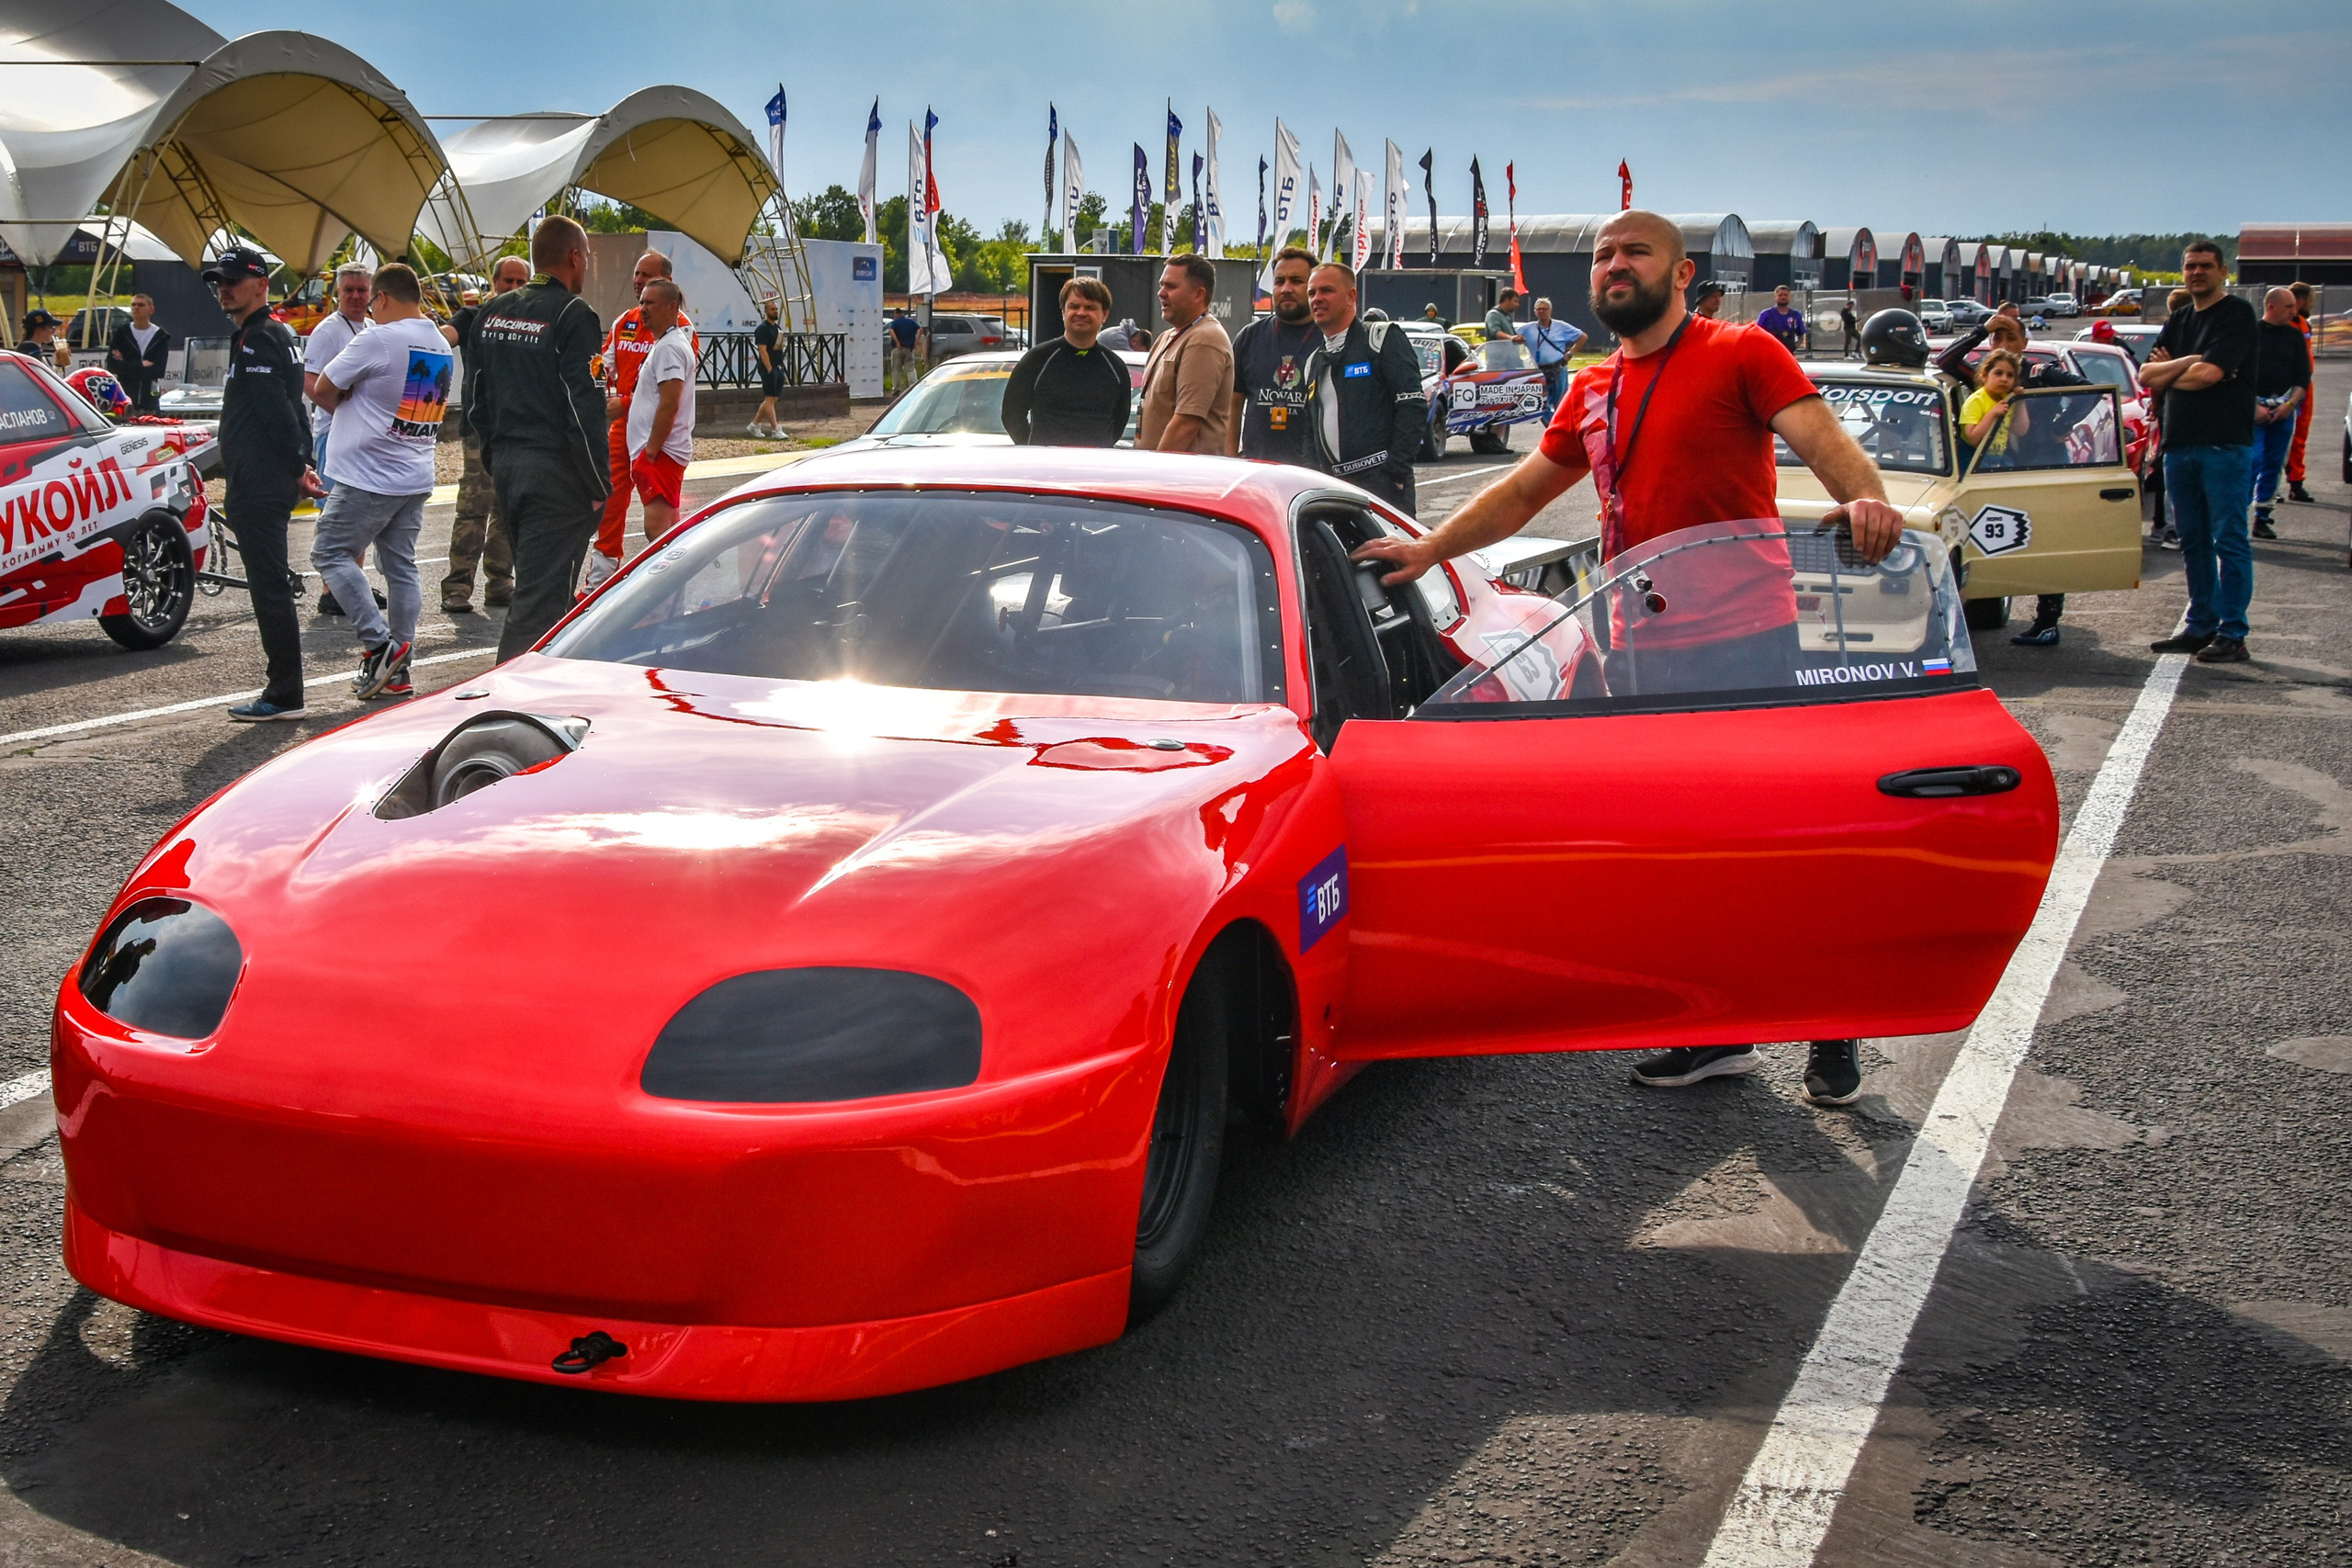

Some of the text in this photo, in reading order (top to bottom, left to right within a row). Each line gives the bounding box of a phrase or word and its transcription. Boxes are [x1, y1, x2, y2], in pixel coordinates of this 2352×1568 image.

[1278, 176, 1295, 221] ВТБ
[1166, 215, 1175, 254] NEZI
[78, 241, 97, 253] ВТБ
[1354, 366, 1368, 375] ВТБ
[1454, 389, 1475, 402] FQ
[1480, 385, 1542, 394] MADE IN JAPAN
[0, 409, 47, 431] АСЛАНОВ
[120, 437, 149, 455] GENESIS
[1343, 453, 1387, 472] DUBOVETS
[0, 457, 133, 556] УКОЙЛ
[1984, 524, 2004, 538] 93
[2, 521, 98, 570] КОГАЛЫМУ 50 ЛЕТ
[1794, 661, 1918, 686] MIRONOV V.
[1317, 873, 1340, 925] ВТБ
